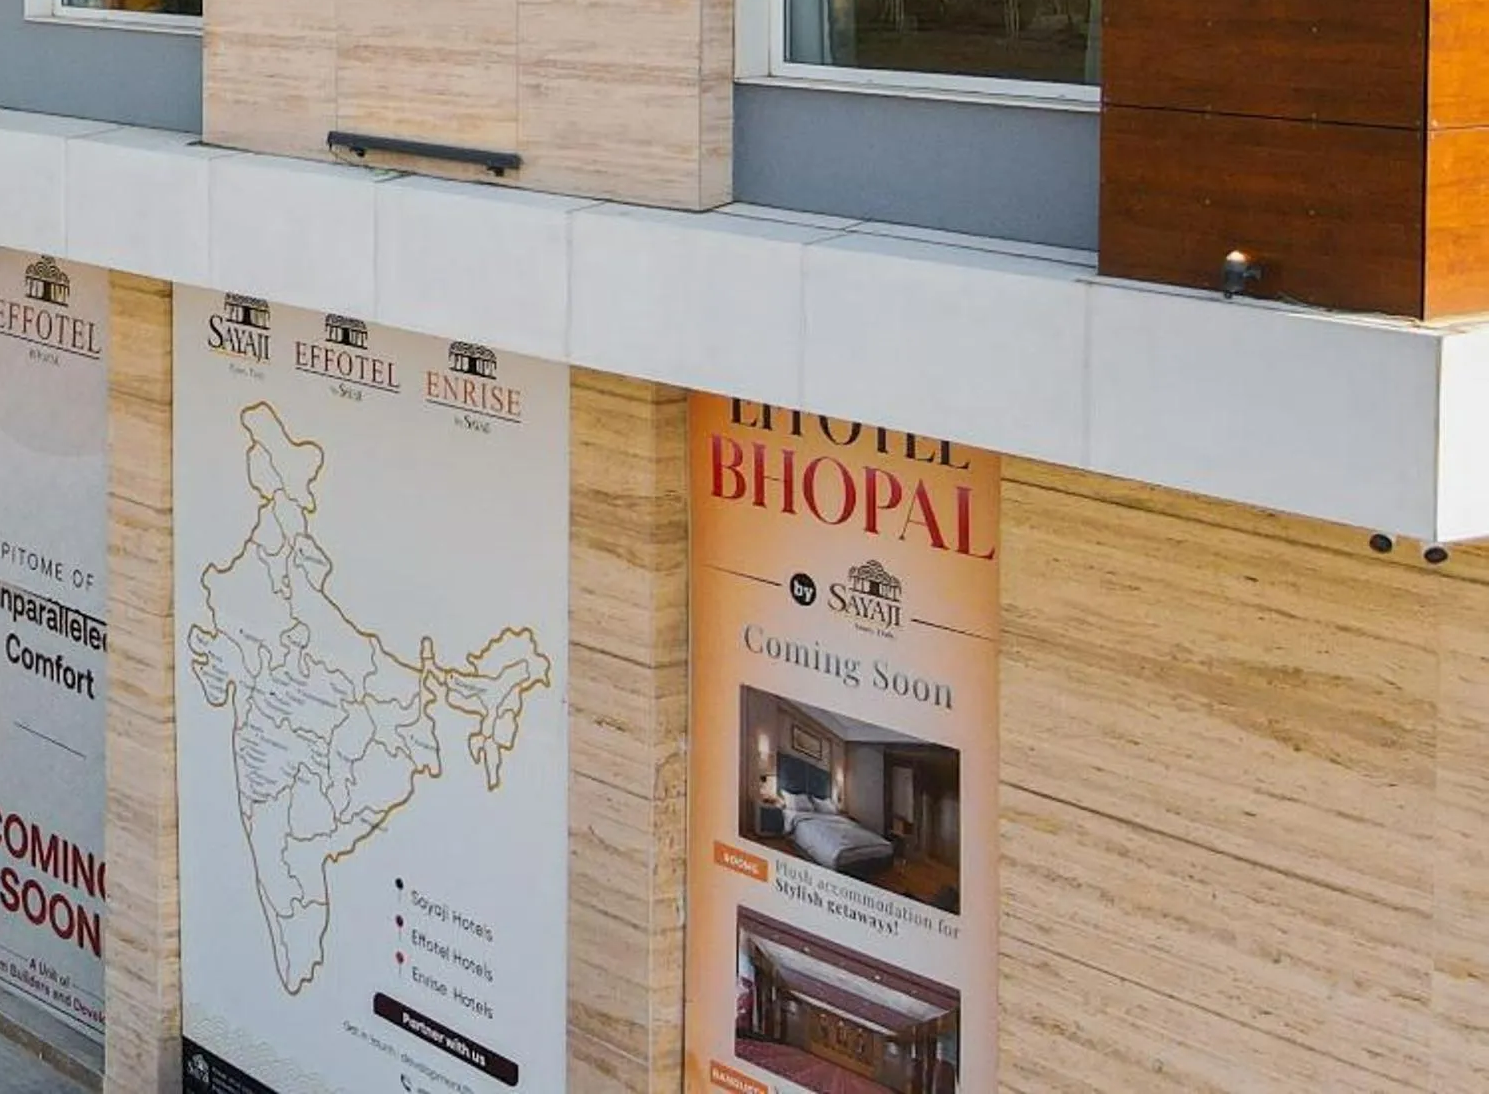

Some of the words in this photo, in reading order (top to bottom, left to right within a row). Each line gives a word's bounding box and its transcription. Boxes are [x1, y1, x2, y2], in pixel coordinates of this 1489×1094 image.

[208, 314, 271, 363] SAYAJI
[295, 341, 400, 388] EFFOTEL
[425, 370, 522, 417] ENRISE
[710, 431, 996, 560] BHOPAL
[72, 569, 96, 592] OF
[793, 581, 815, 604] by
[827, 582, 902, 629] SAYAJI
[5, 633, 96, 700] Comfort
[743, 623, 861, 688] Coming
[872, 659, 953, 710] Soon
[0, 866, 102, 959] SOON
[775, 879, 823, 910] Stylish
[827, 897, 900, 937] getaways!
[937, 918, 961, 940] for
[445, 1037, 471, 1059] with
[471, 1050, 487, 1067] us
